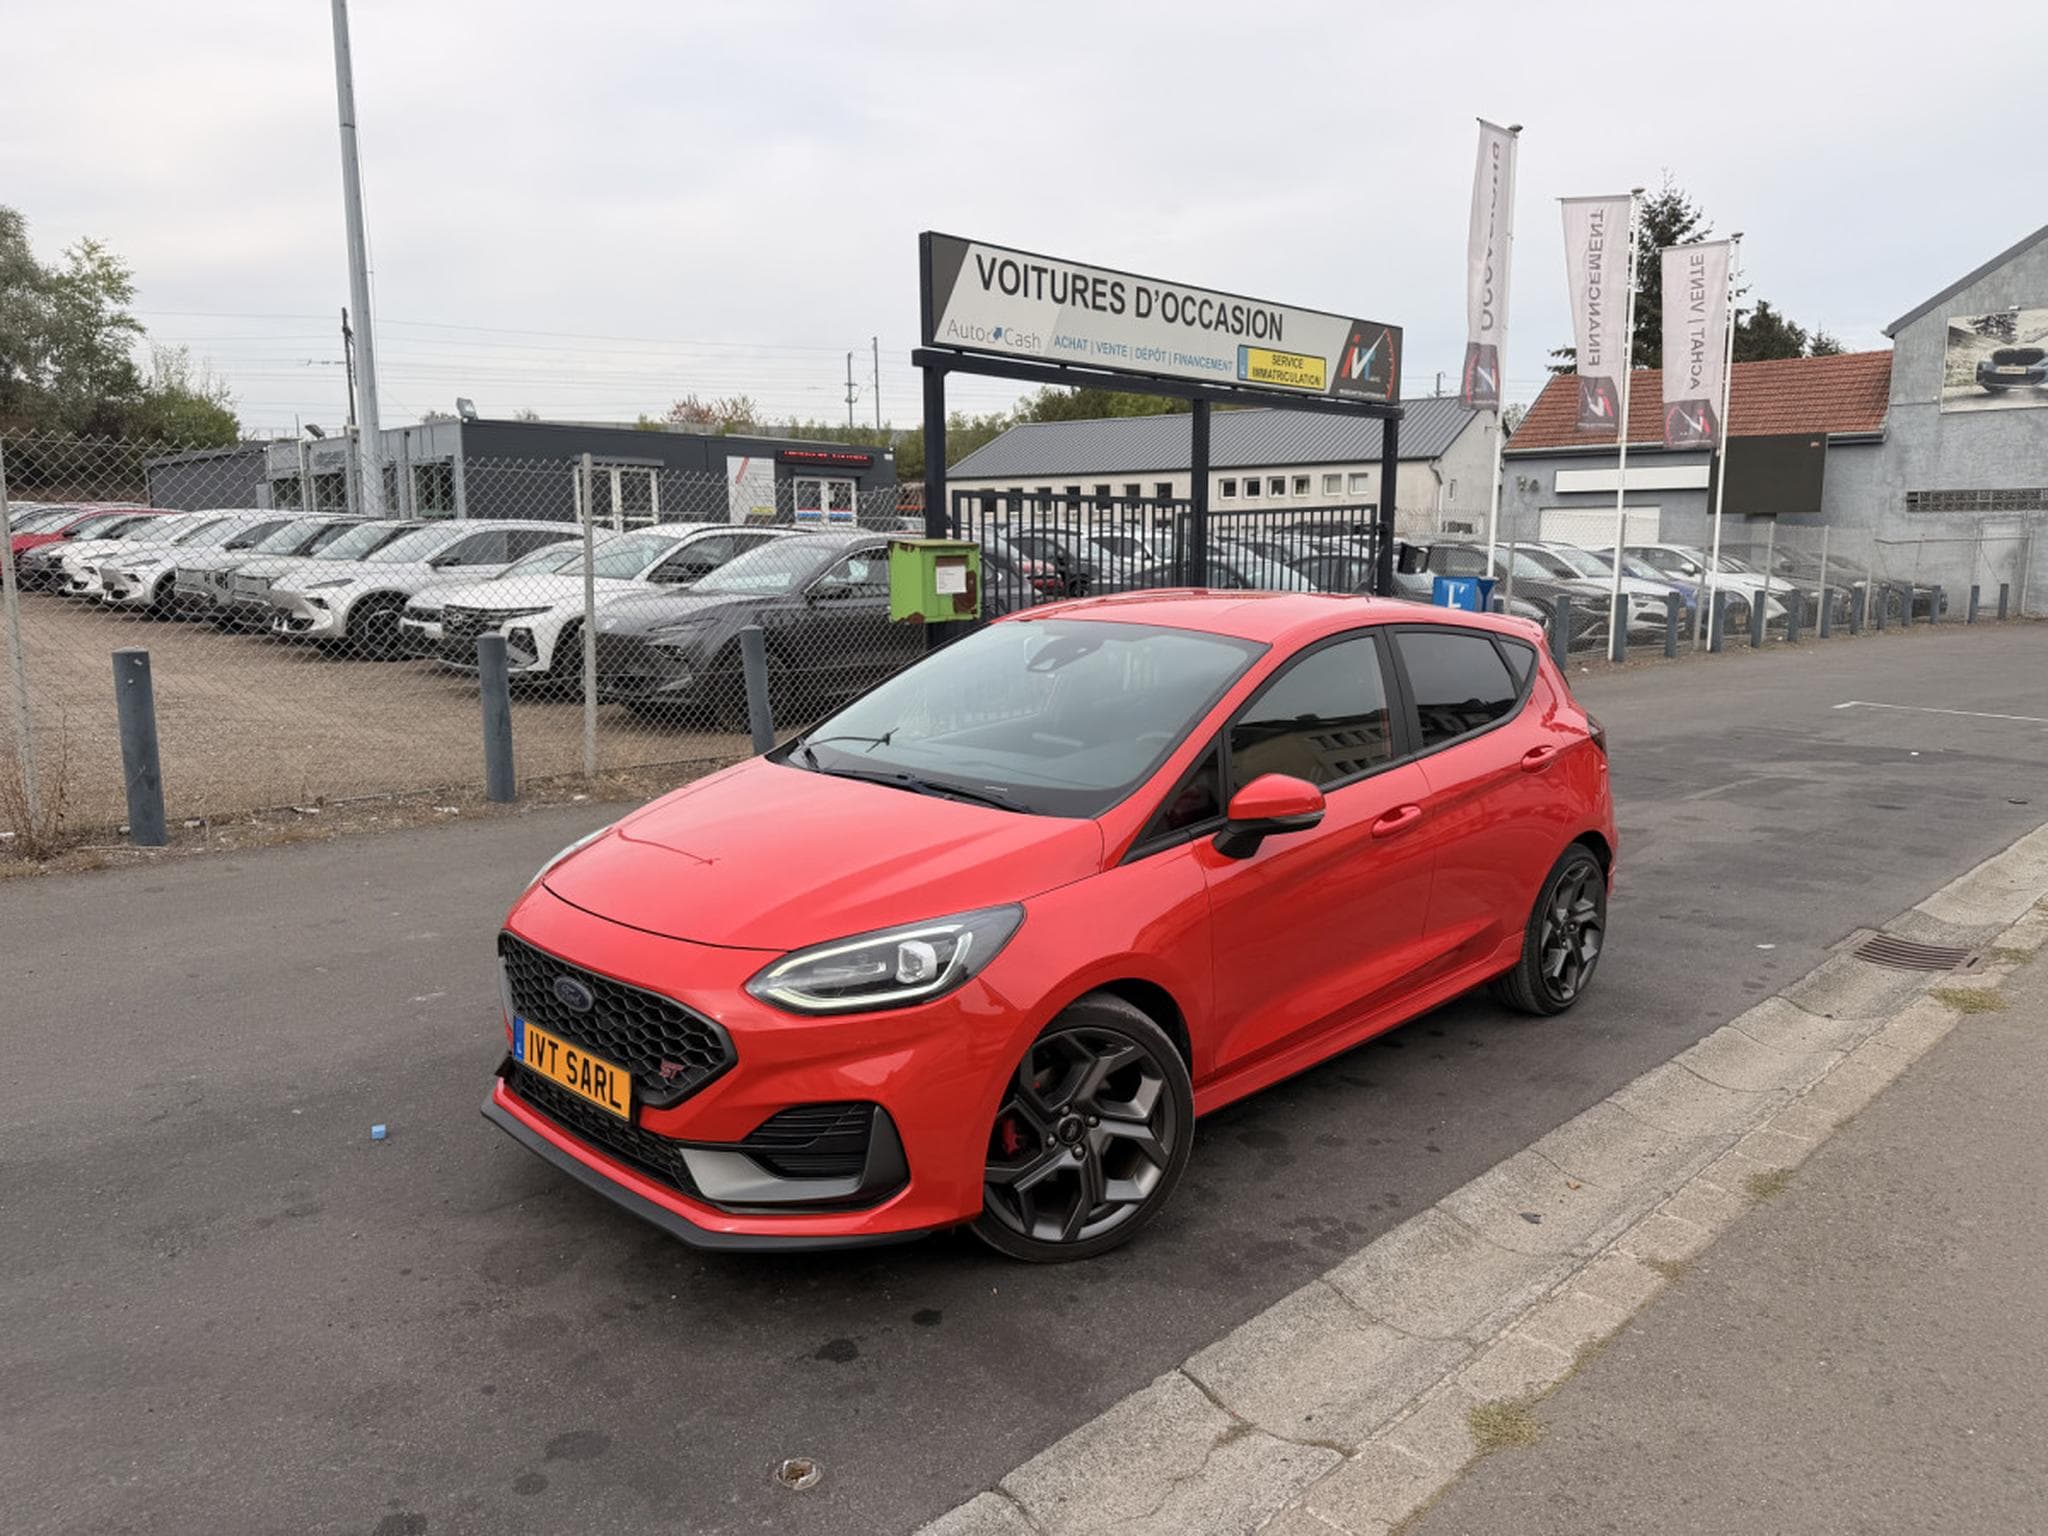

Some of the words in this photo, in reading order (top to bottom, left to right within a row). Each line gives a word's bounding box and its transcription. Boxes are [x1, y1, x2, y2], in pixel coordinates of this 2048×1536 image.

[976, 253, 1126, 315] VOITURES
[1135, 285, 1283, 342] D'OCCASION
[1054, 335, 1088, 350] ACHAT
[1096, 342, 1128, 358] VENTE
[1173, 351, 1233, 372] FINANCEMENT
[1272, 354, 1304, 369] SERVICE
[529, 1030, 559, 1075] IVT
[566, 1050, 622, 1110] SARL
